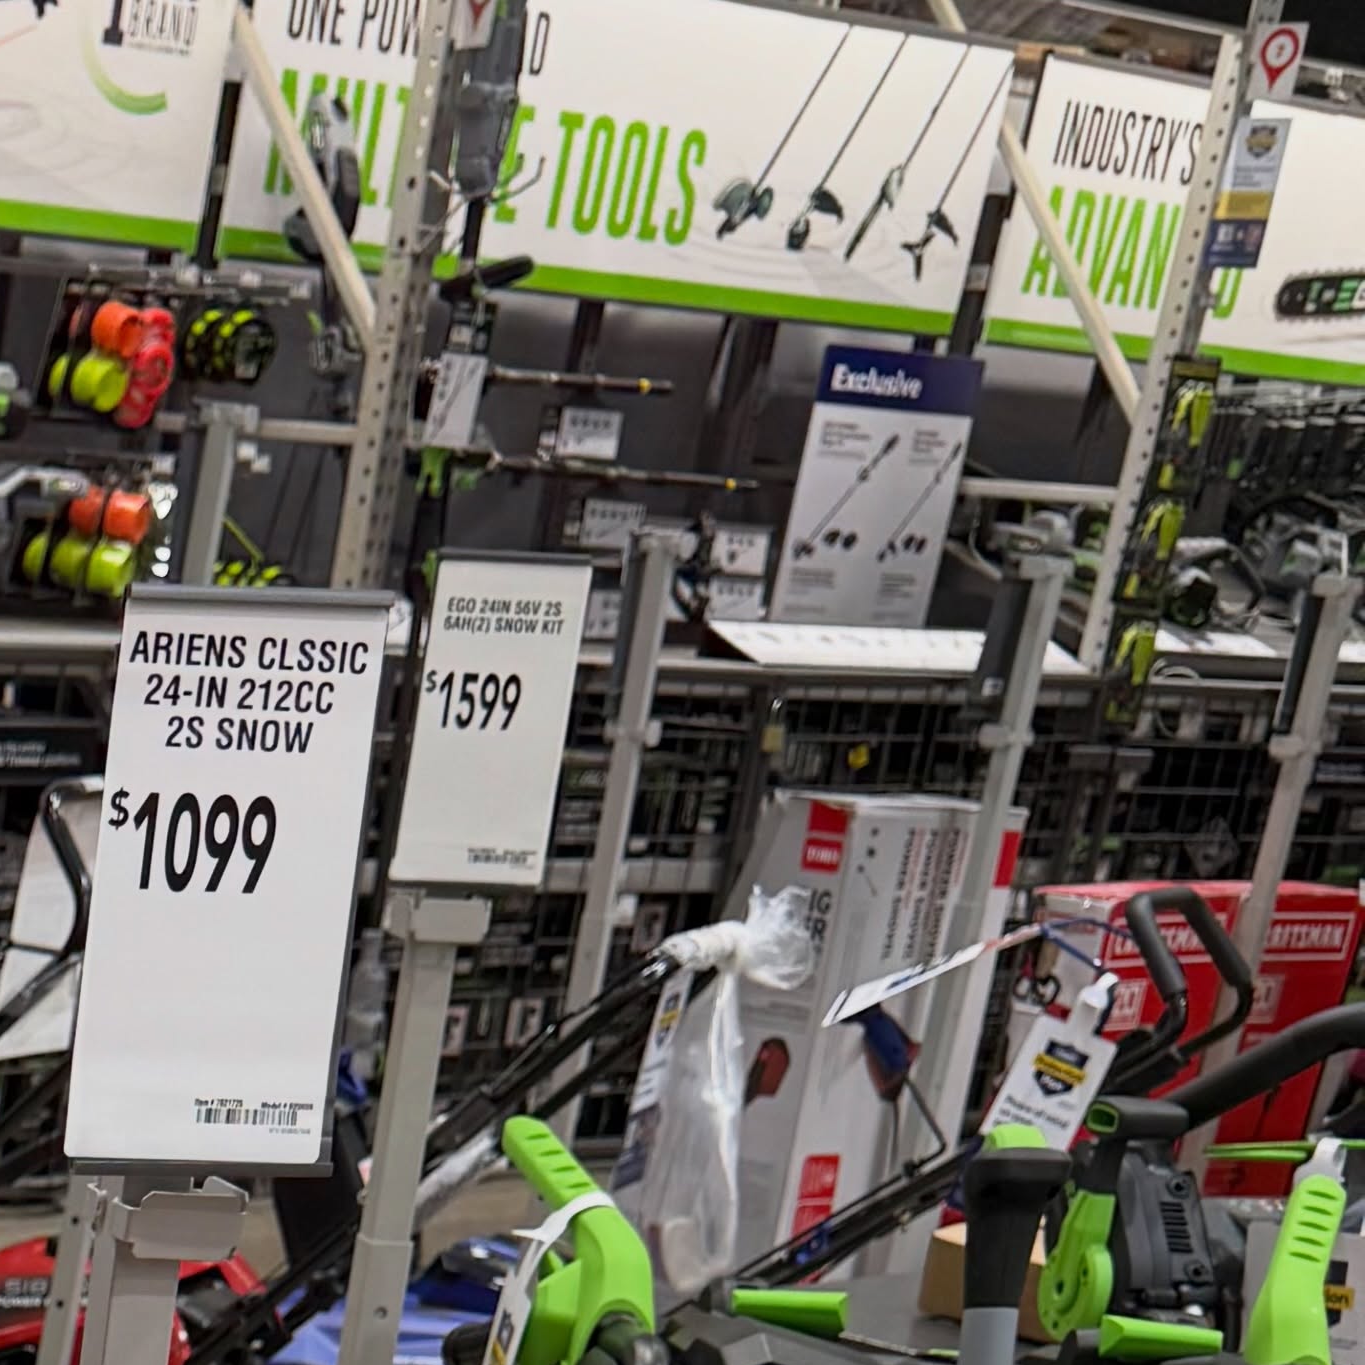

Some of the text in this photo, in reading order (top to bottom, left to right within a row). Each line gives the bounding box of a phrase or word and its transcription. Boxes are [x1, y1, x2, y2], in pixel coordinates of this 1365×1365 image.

[1053, 99, 1203, 185] INDUSTRY'S
[547, 110, 708, 246] TOOLS
[830, 363, 923, 399] Exclusive
[443, 615, 565, 635] 6AH(2) SNOW KIT
[447, 596, 562, 617] EGO 24IN 56V 2S
[129, 630, 370, 675] ARIENS CLSSIC
[143, 674, 335, 714] 24-IN 212CC
[425, 669, 522, 731] $1599
[165, 716, 314, 754] 2S SNOW
[107, 786, 277, 895] $1099
